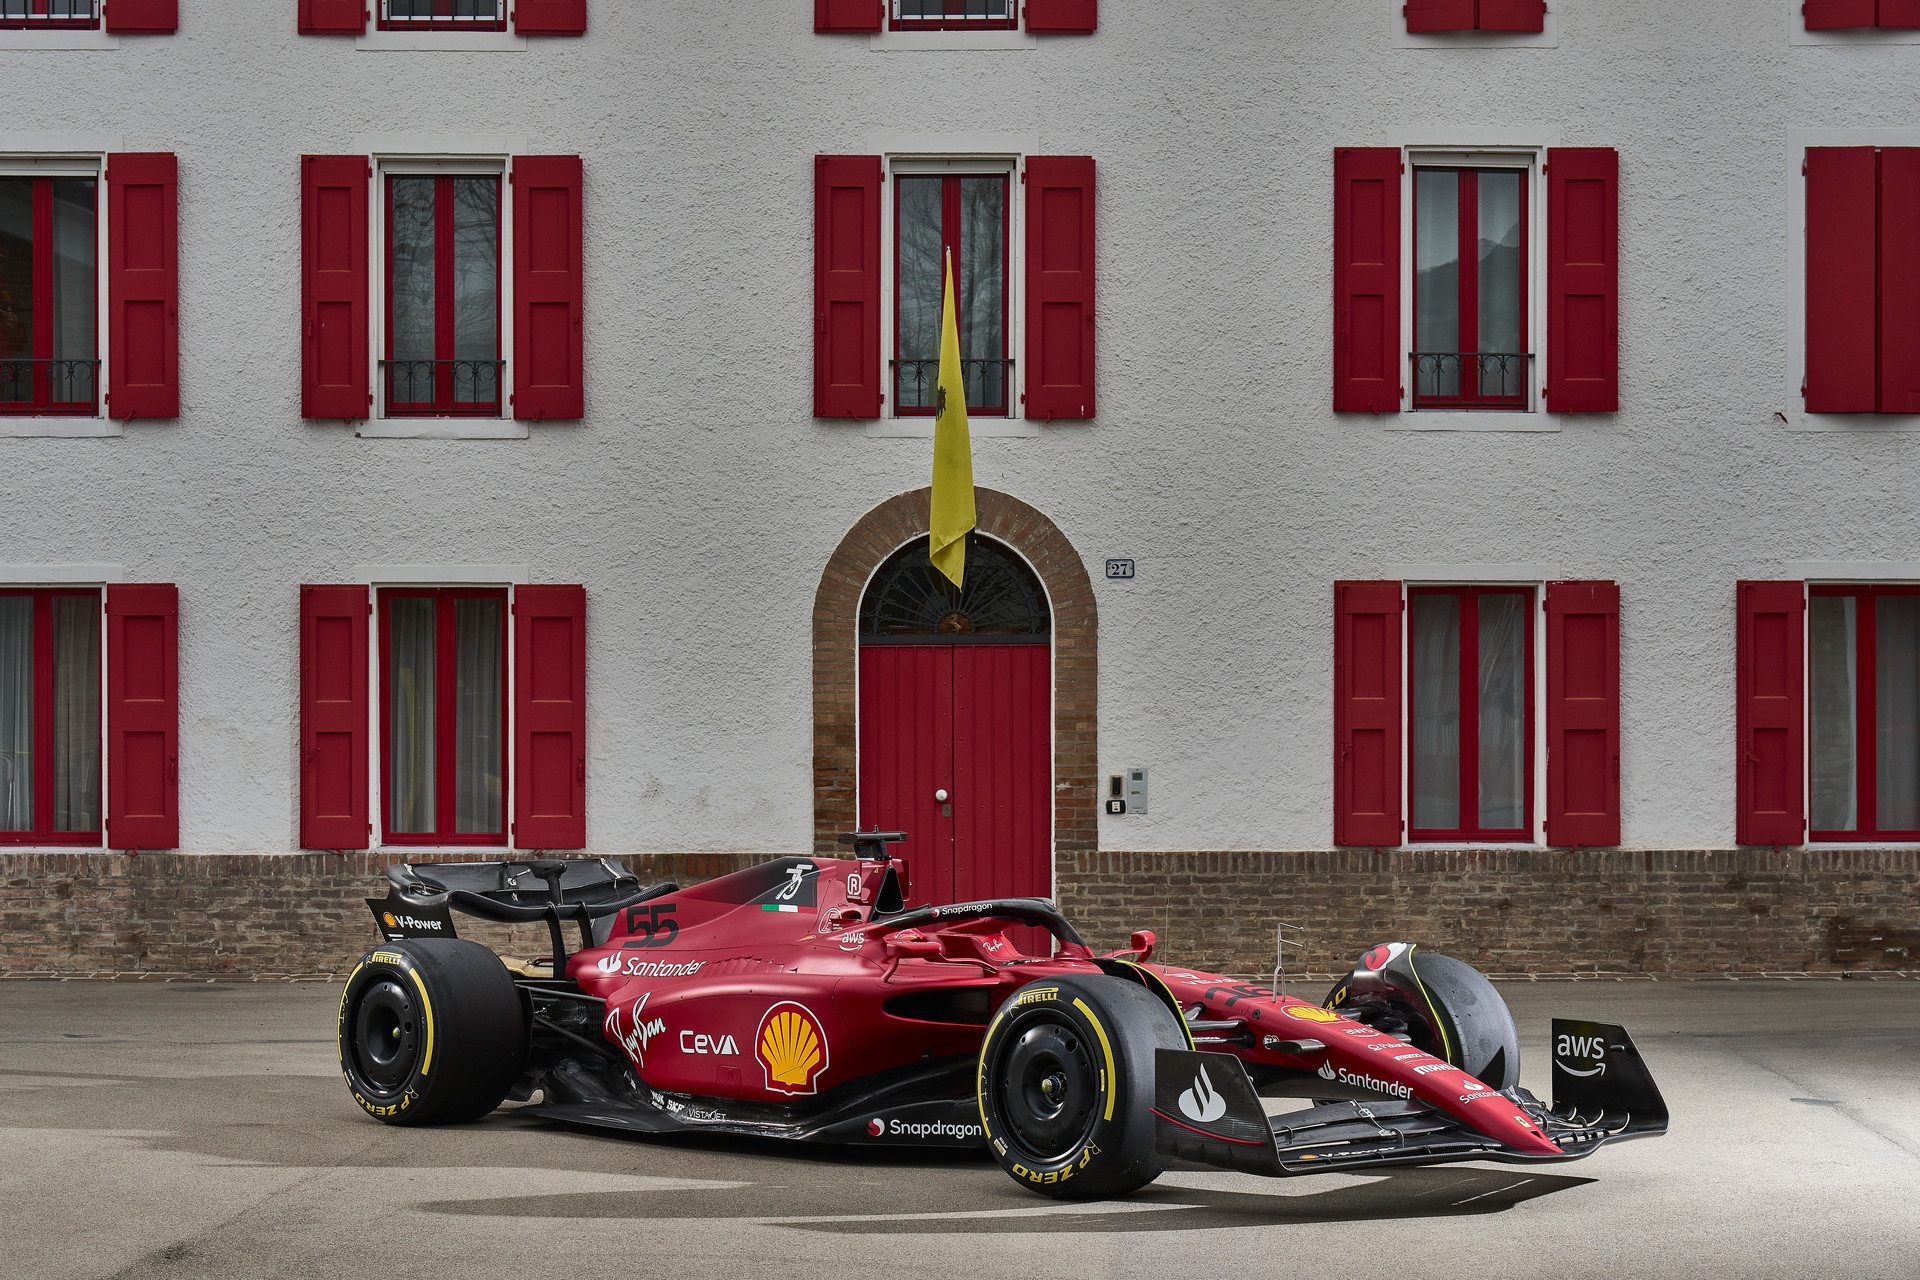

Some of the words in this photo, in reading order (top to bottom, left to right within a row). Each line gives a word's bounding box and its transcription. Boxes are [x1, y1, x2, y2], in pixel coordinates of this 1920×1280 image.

[1111, 563, 1128, 576] 27
[942, 903, 993, 915] Snapdragon
[394, 915, 442, 930] V-Power
[622, 903, 679, 949] 55
[841, 932, 865, 944] aws
[372, 951, 402, 965] PIRELLI
[621, 956, 707, 977] Santander
[1017, 987, 1059, 1005] PIRELLI
[1204, 984, 1282, 1008] 16
[1557, 1034, 1605, 1059] aws
[1338, 1068, 1414, 1099] Santander
[355, 1092, 398, 1116] ZERO
[400, 1094, 410, 1110] P
[666, 1099, 685, 1113] SKF
[688, 1107, 727, 1120] VISTAJET
[889, 1119, 982, 1139] Snapdragon
[1078, 1147, 1090, 1169] P
[1012, 1162, 1075, 1185] ZERO
